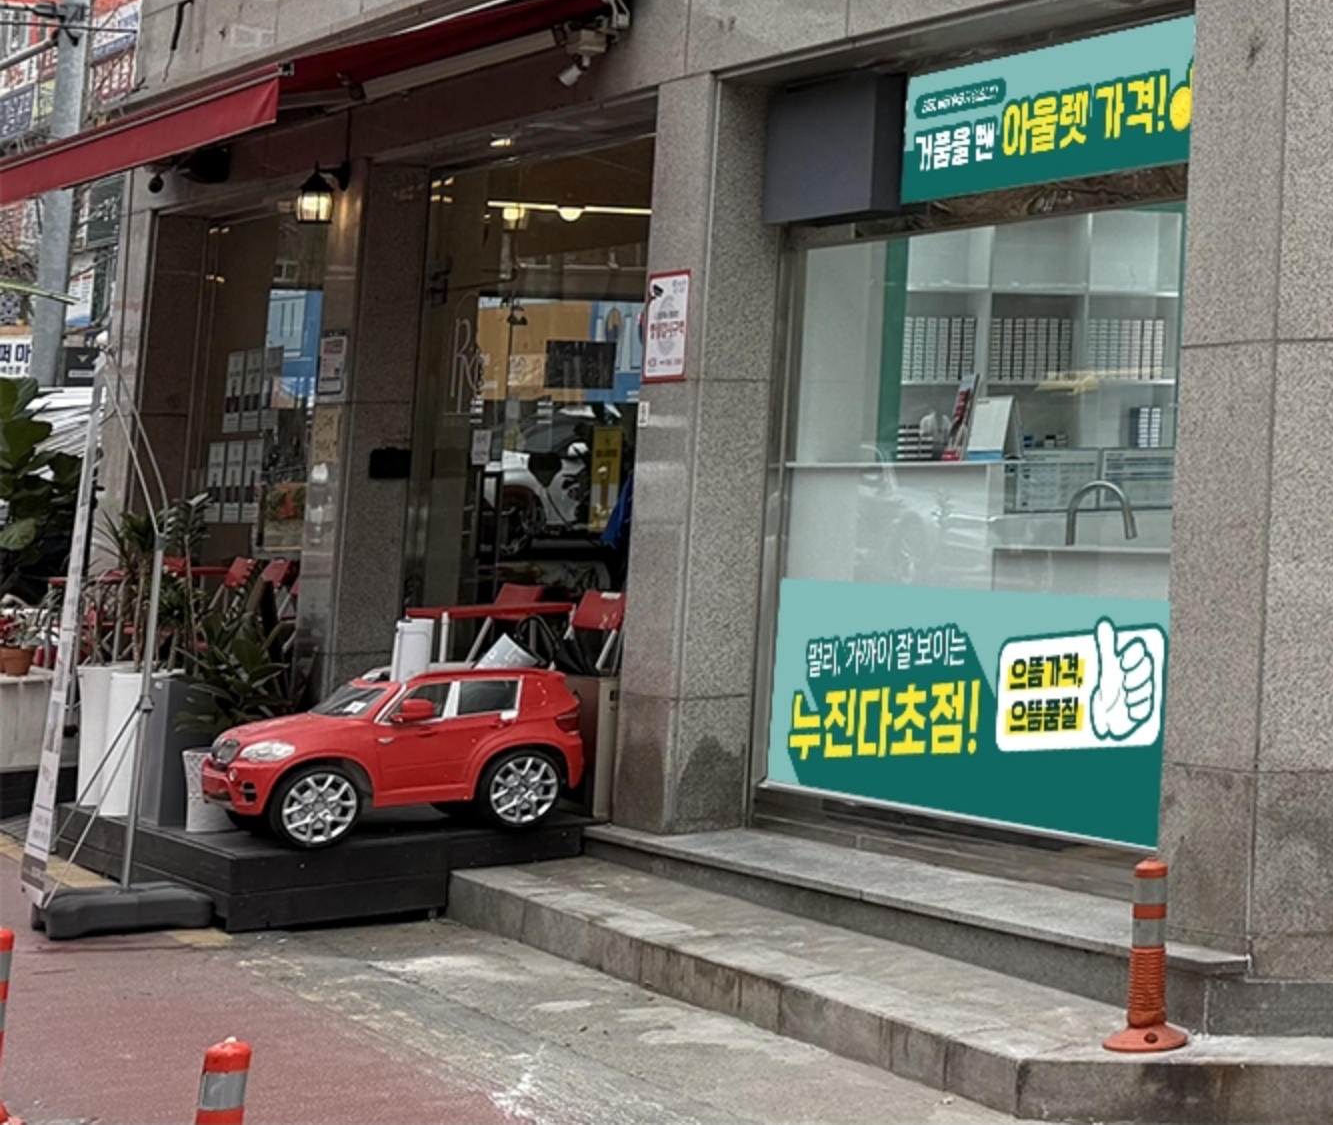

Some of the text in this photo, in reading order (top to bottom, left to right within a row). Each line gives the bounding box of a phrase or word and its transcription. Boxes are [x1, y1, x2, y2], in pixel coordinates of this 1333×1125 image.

[915, 127, 970, 171] 거품을
[1002, 90, 1090, 156] 아울렛
[1096, 75, 1167, 138] 가격!
[808, 628, 966, 677] 멀리, 가까이 잘 보이는
[789, 679, 980, 760] 누진다초점!
